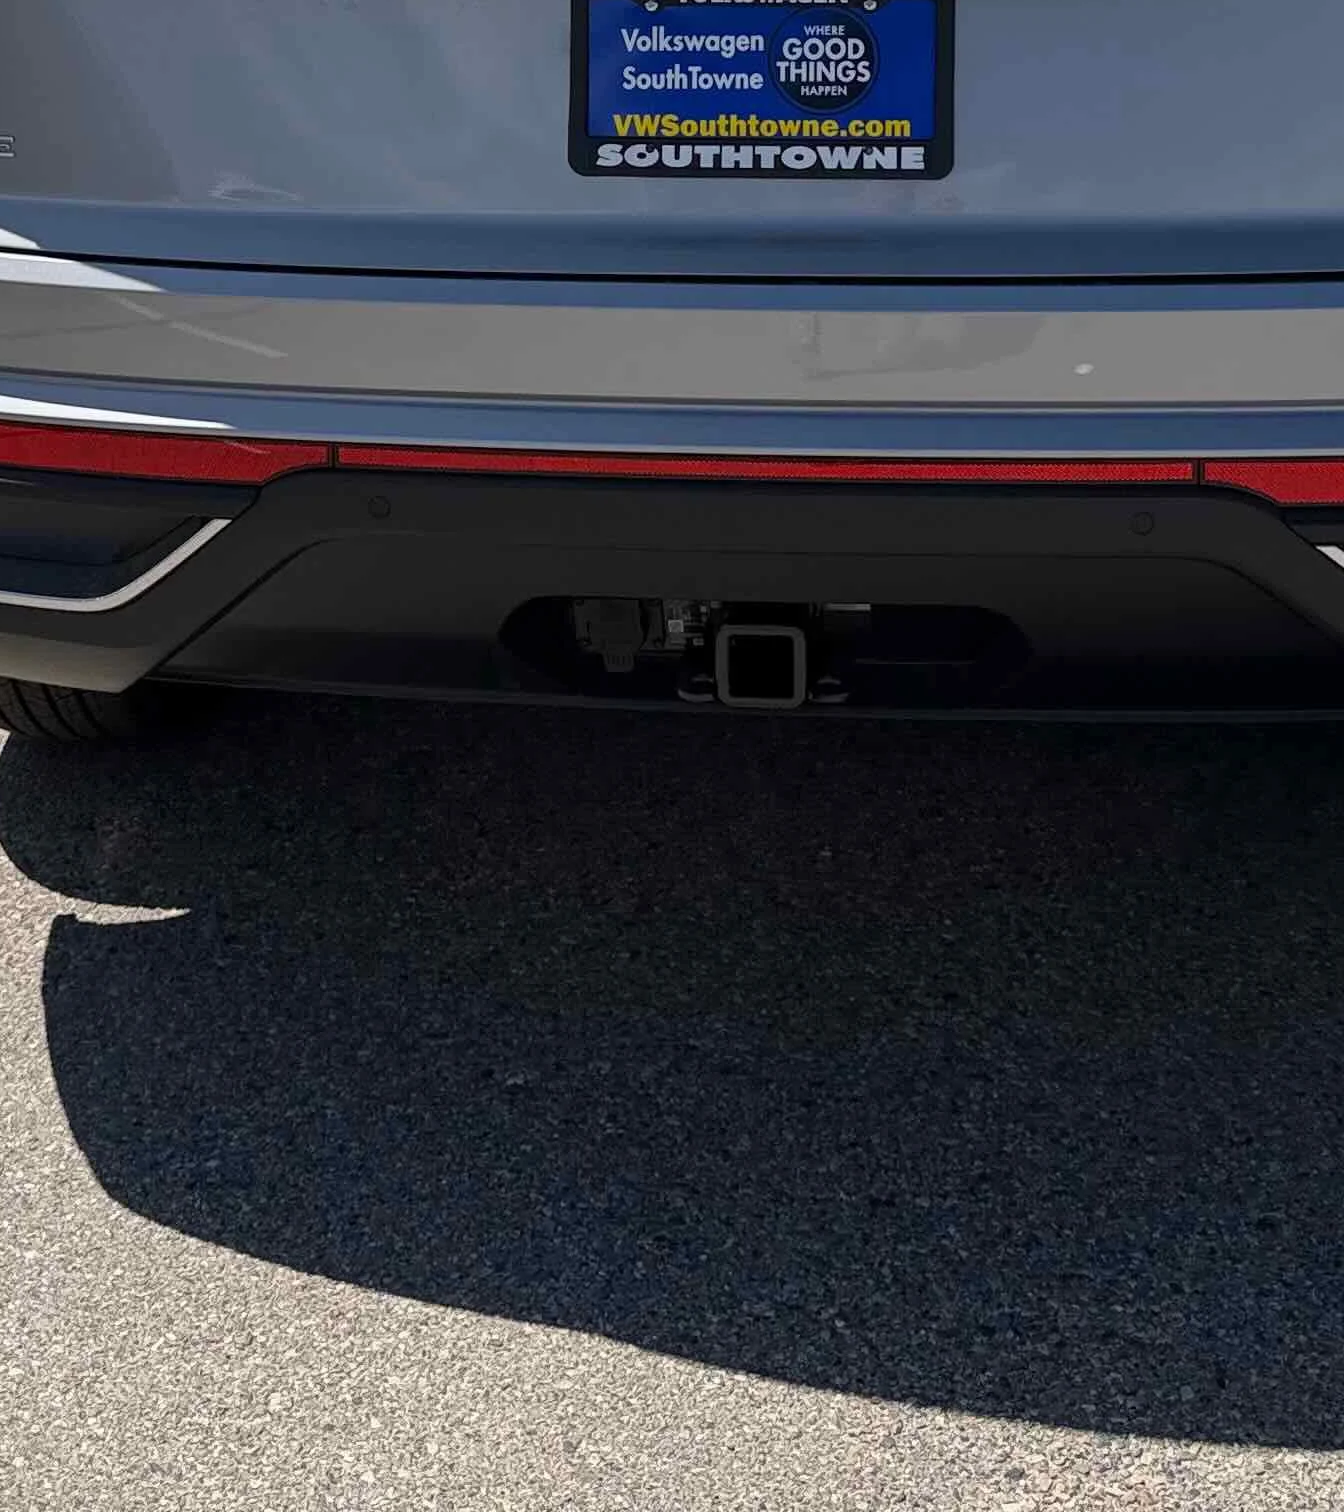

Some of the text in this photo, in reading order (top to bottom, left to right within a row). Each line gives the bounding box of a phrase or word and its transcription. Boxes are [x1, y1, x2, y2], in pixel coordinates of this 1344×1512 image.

[621, 26, 765, 58] Volkswagen
[804, 25, 845, 36] WHERE
[782, 37, 865, 61] GOOD
[622, 63, 764, 91] SouthTowne
[776, 61, 872, 84] THINGS
[800, 85, 848, 97] HAPPEN
[613, 113, 912, 137] VWSouthtowne.com
[596, 143, 927, 170] SOUTHTOWNE
